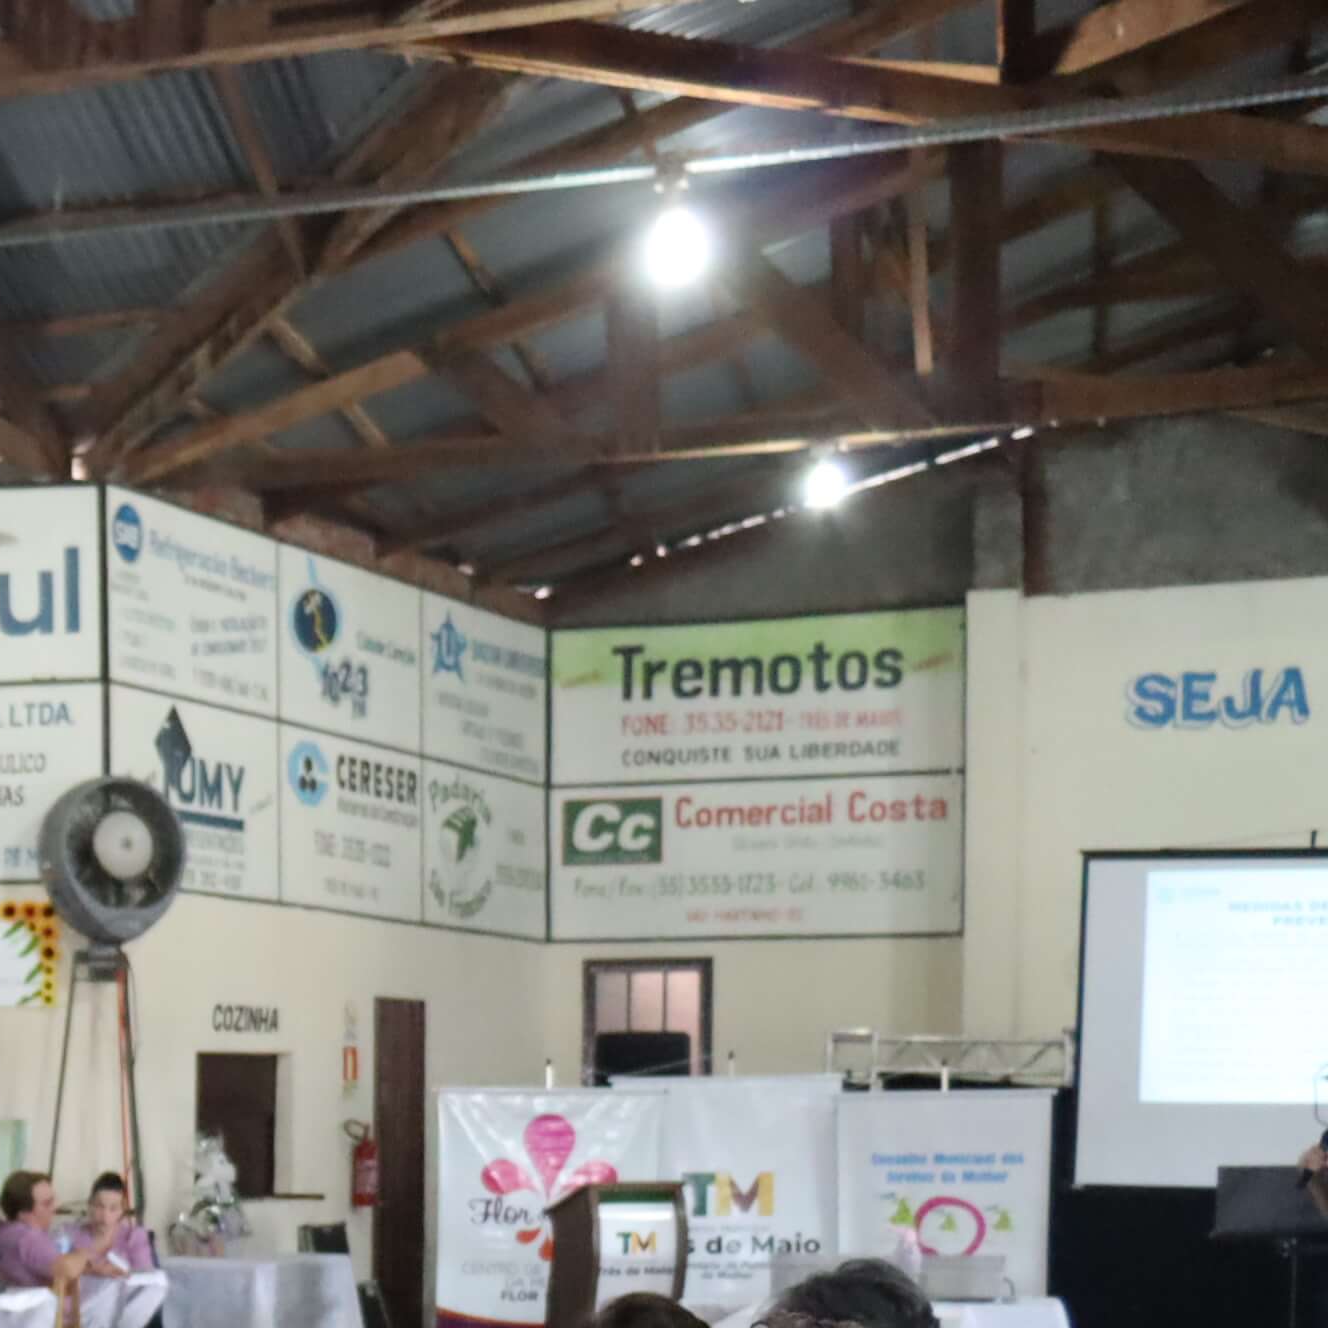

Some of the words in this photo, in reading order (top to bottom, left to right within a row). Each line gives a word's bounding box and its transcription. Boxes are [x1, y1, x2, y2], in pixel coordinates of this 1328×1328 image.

[611, 641, 905, 702] Tremotos
[1126, 666, 1311, 730] SEJA
[621, 746, 732, 768] CONQUISTE
[744, 744, 780, 762] SUA
[789, 739, 901, 761] LIBERDADE
[336, 754, 419, 803] CERESER
[571, 801, 657, 854] Cc
[673, 791, 834, 830] Comercial
[847, 790, 949, 824] Costa
[211, 1003, 279, 1033] COZINHA
[682, 1170, 775, 1217] TM
[616, 1231, 658, 1256] TM
[705, 1235, 743, 1255] de
[751, 1231, 822, 1255] Maio
[500, 1289, 540, 1302] FLOR
